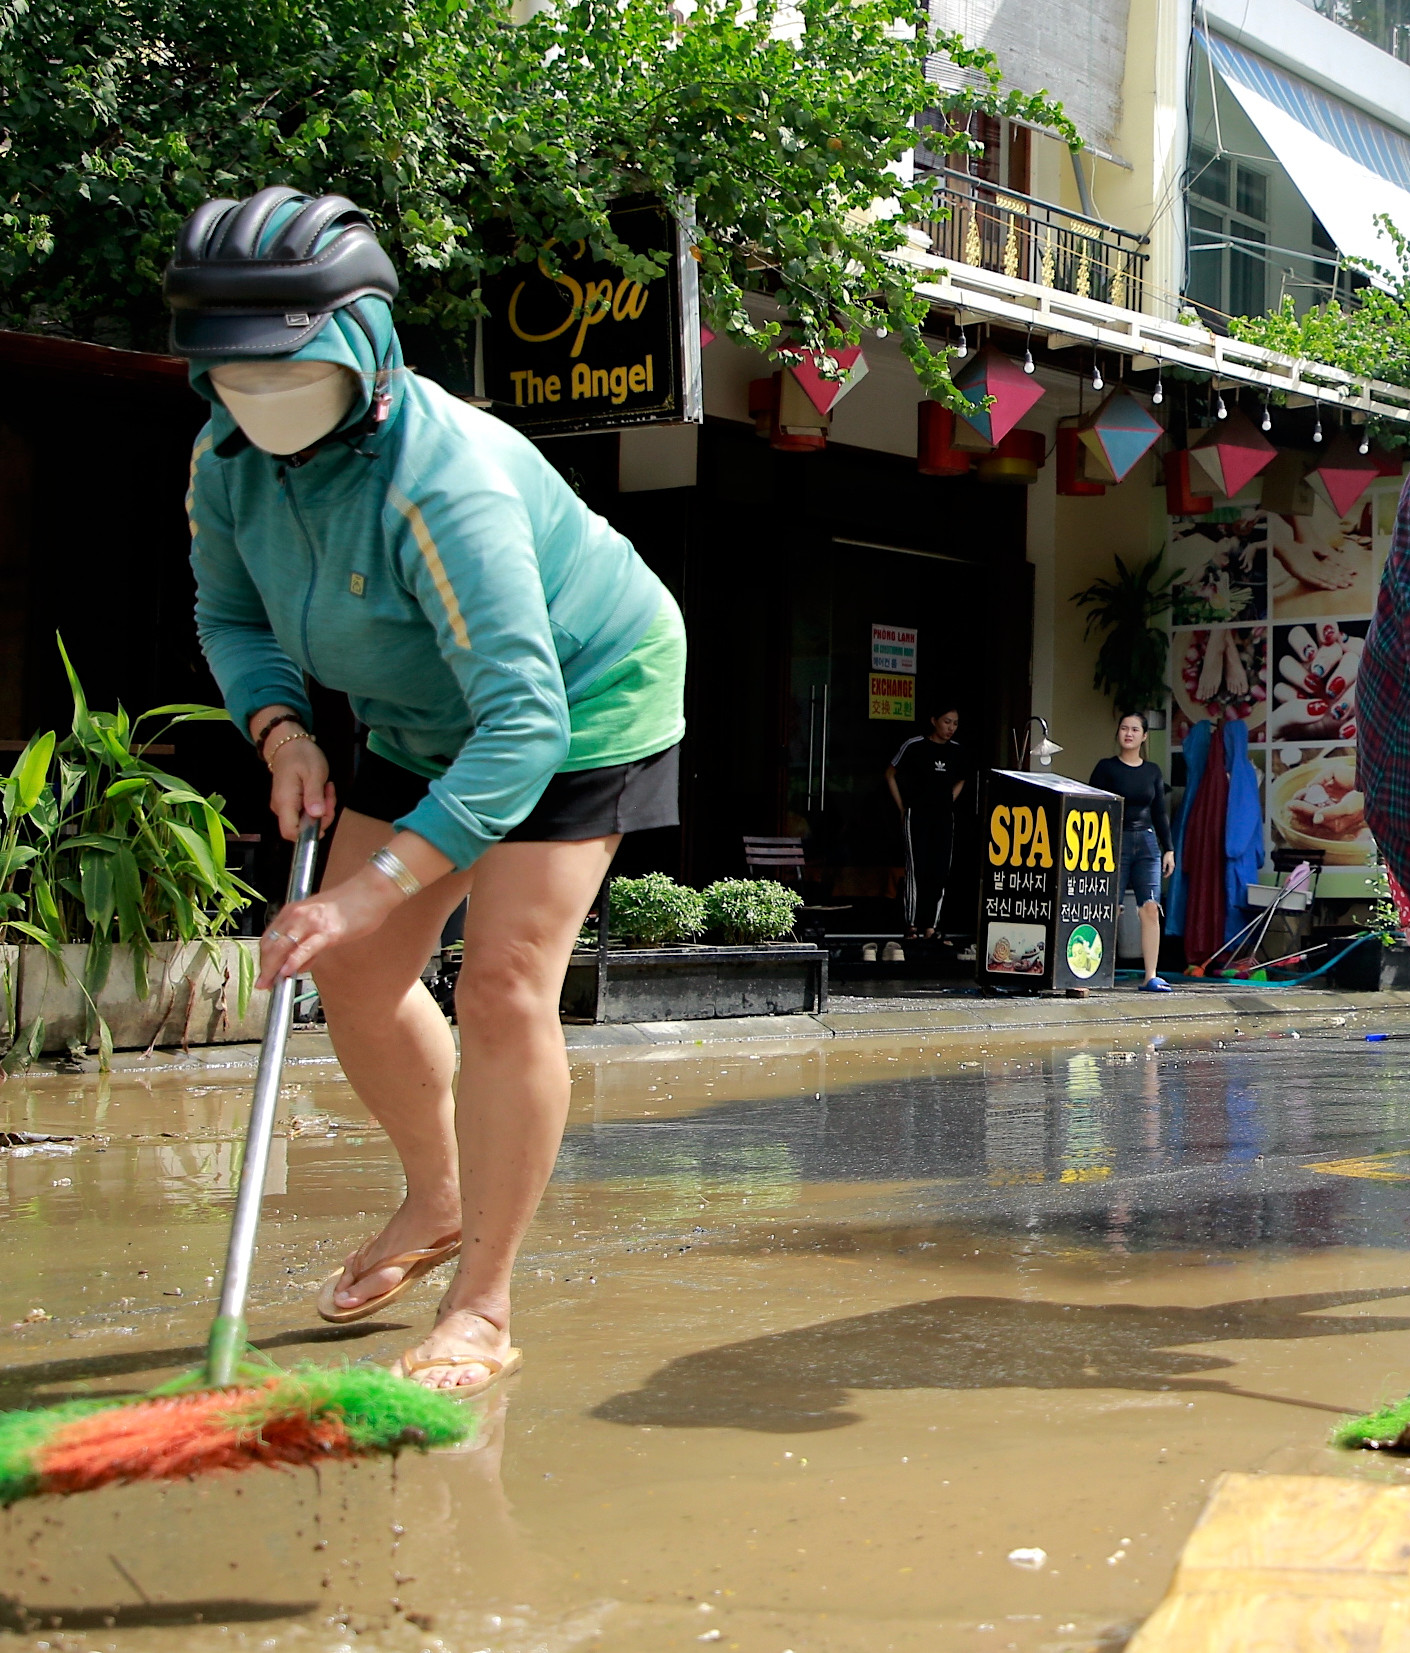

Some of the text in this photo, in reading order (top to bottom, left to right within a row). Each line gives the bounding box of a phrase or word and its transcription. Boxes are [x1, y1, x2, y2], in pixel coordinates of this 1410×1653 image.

[508, 237, 649, 358] Spa
[510, 354, 653, 407] The Angel
[872, 677, 912, 698] EXCHANGE
[893, 700, 912, 717] 교환
[988, 804, 1053, 869] SPA
[1064, 809, 1116, 873] SPA
[993, 871, 1047, 893] 발 마사지
[1067, 876, 1110, 897] 발 마사지
[985, 897, 1052, 920] 전신 마사지
[1060, 903, 1114, 923] 전신 마사지
